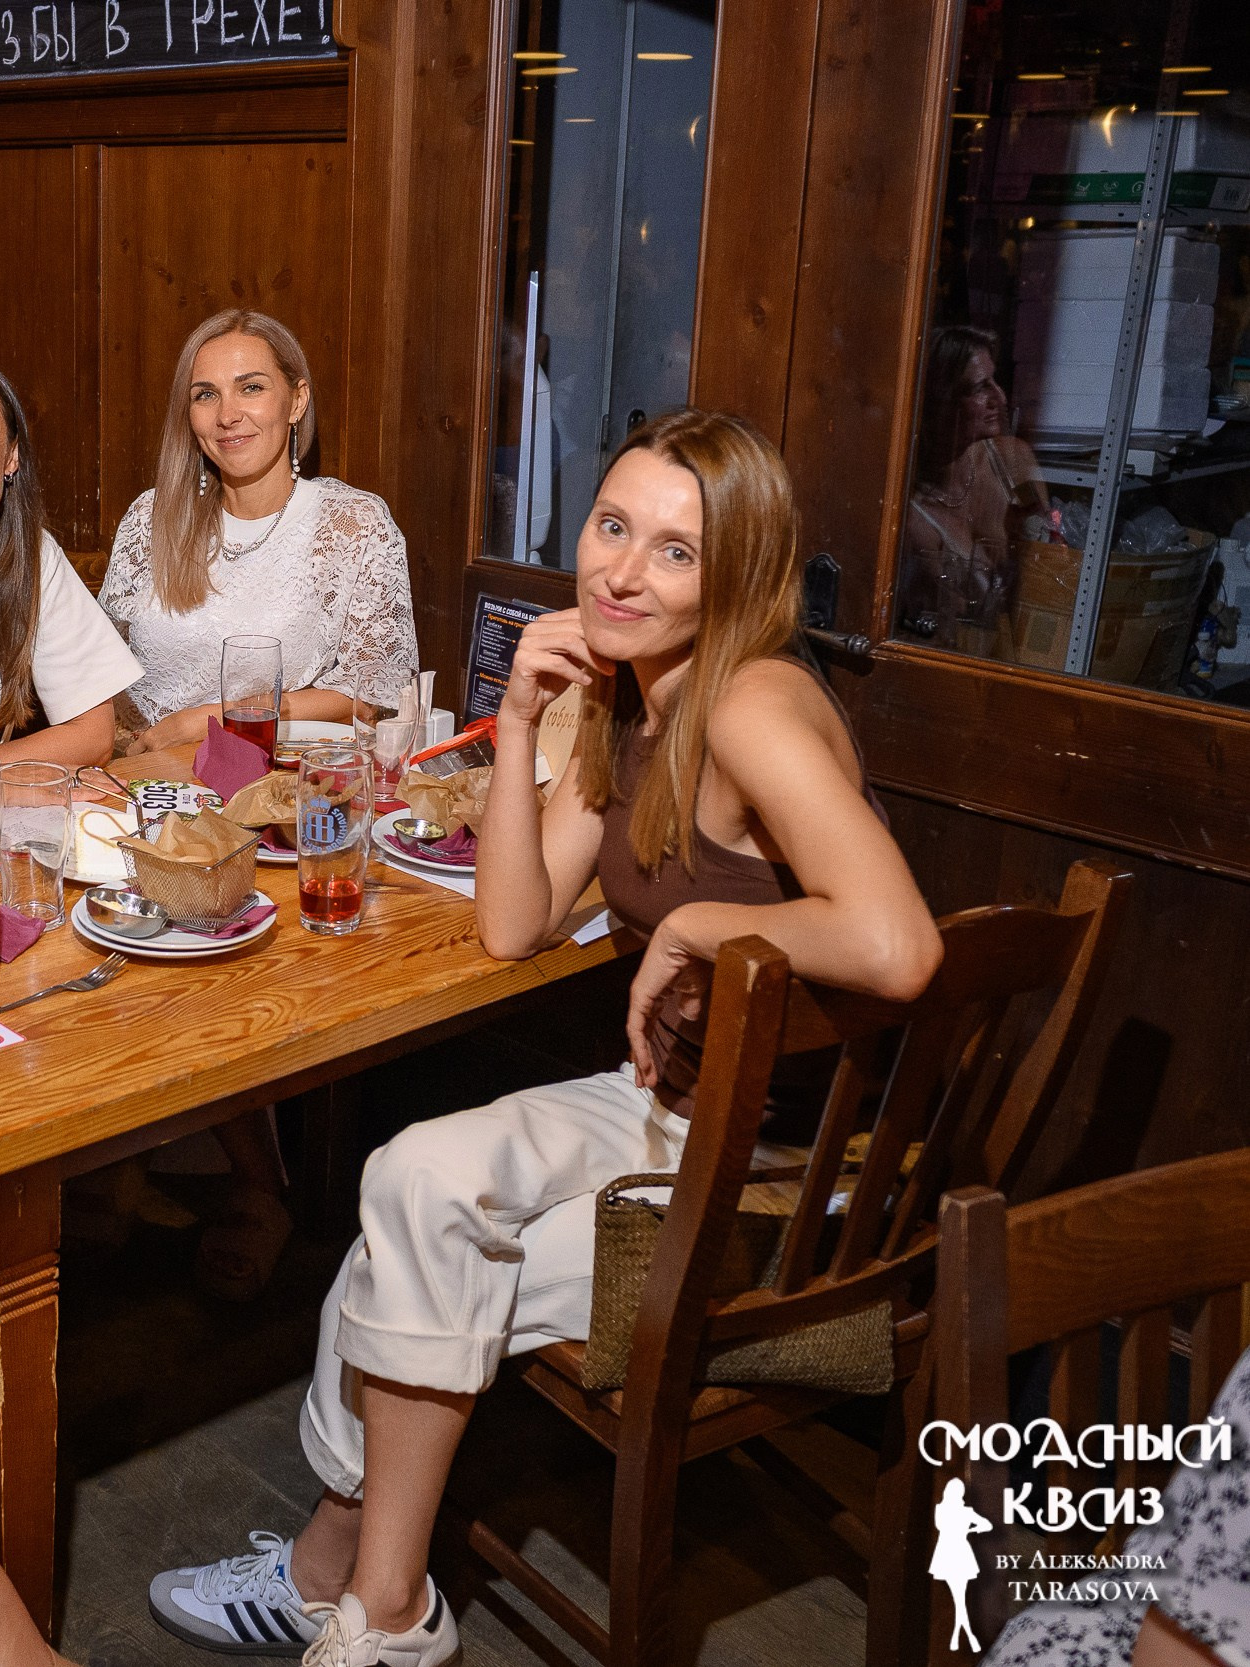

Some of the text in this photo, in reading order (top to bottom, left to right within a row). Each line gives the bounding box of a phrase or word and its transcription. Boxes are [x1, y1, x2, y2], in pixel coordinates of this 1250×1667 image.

[31, 1, 77, 63] БЫ
[105, 0, 130, 59] В
[142, 785, 178, 810] 503
